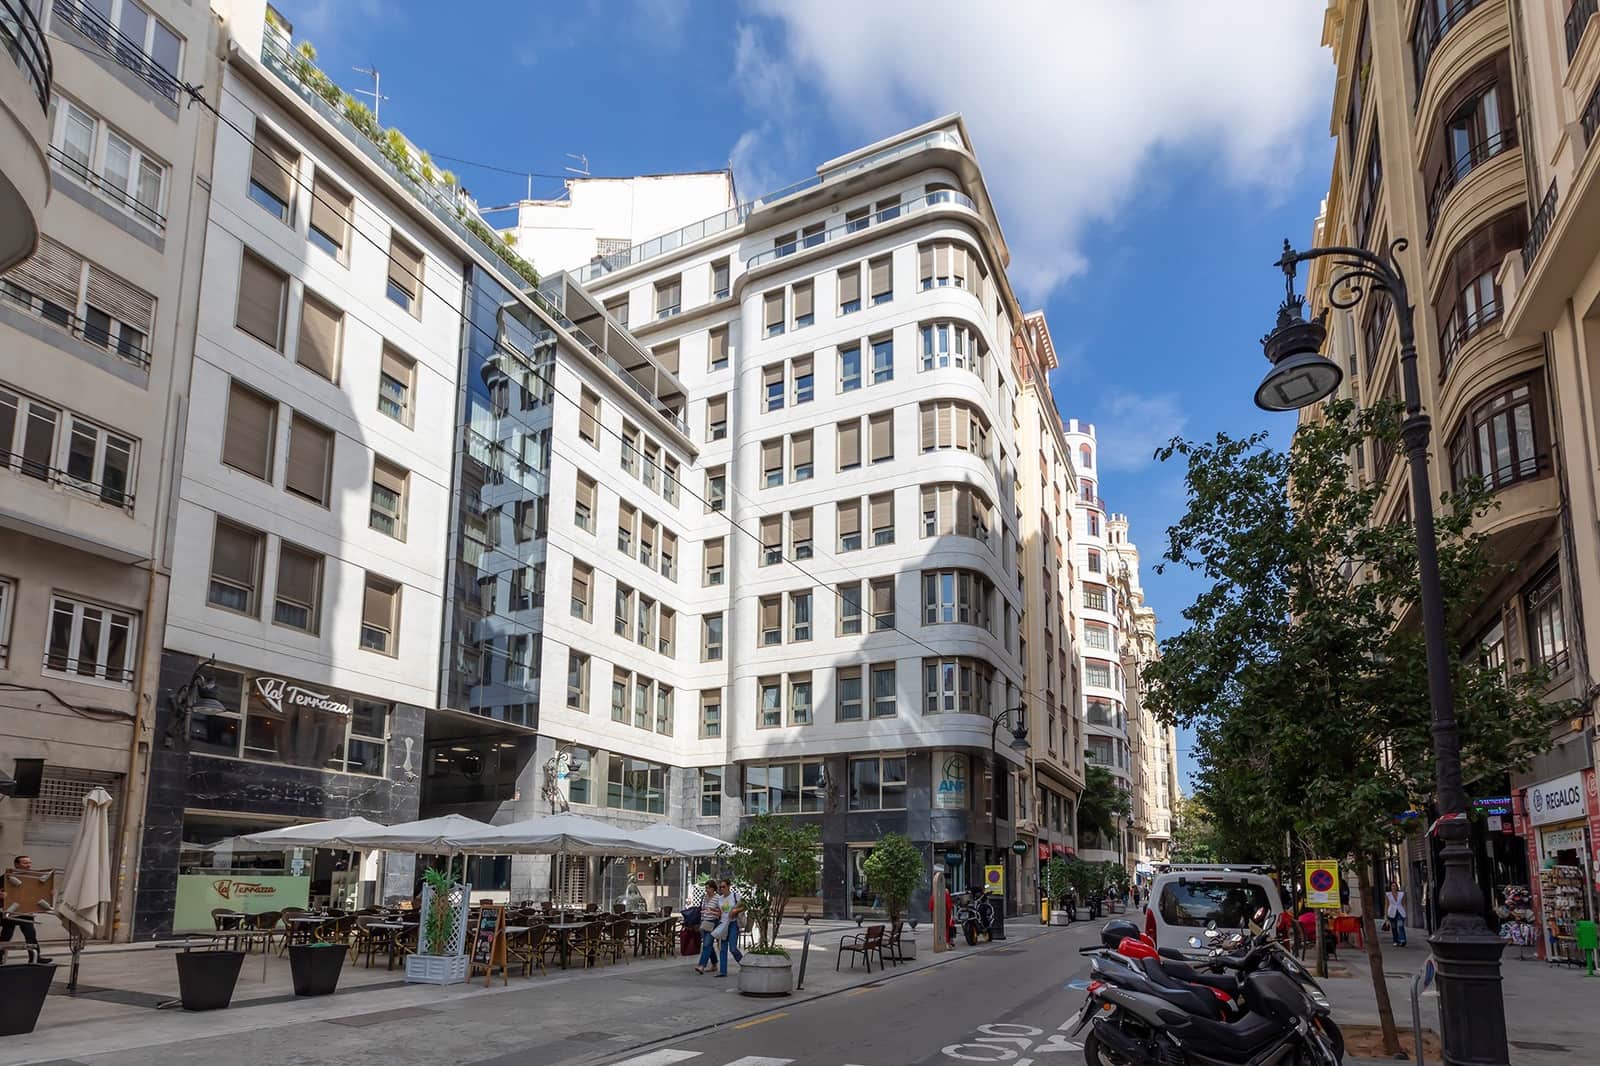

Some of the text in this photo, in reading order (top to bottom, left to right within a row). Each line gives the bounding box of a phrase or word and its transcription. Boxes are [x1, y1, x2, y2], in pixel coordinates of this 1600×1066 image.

[287, 686, 351, 714] Terrazza
[1545, 785, 1580, 810] REGALOS
[233, 882, 276, 894] Terrazza
